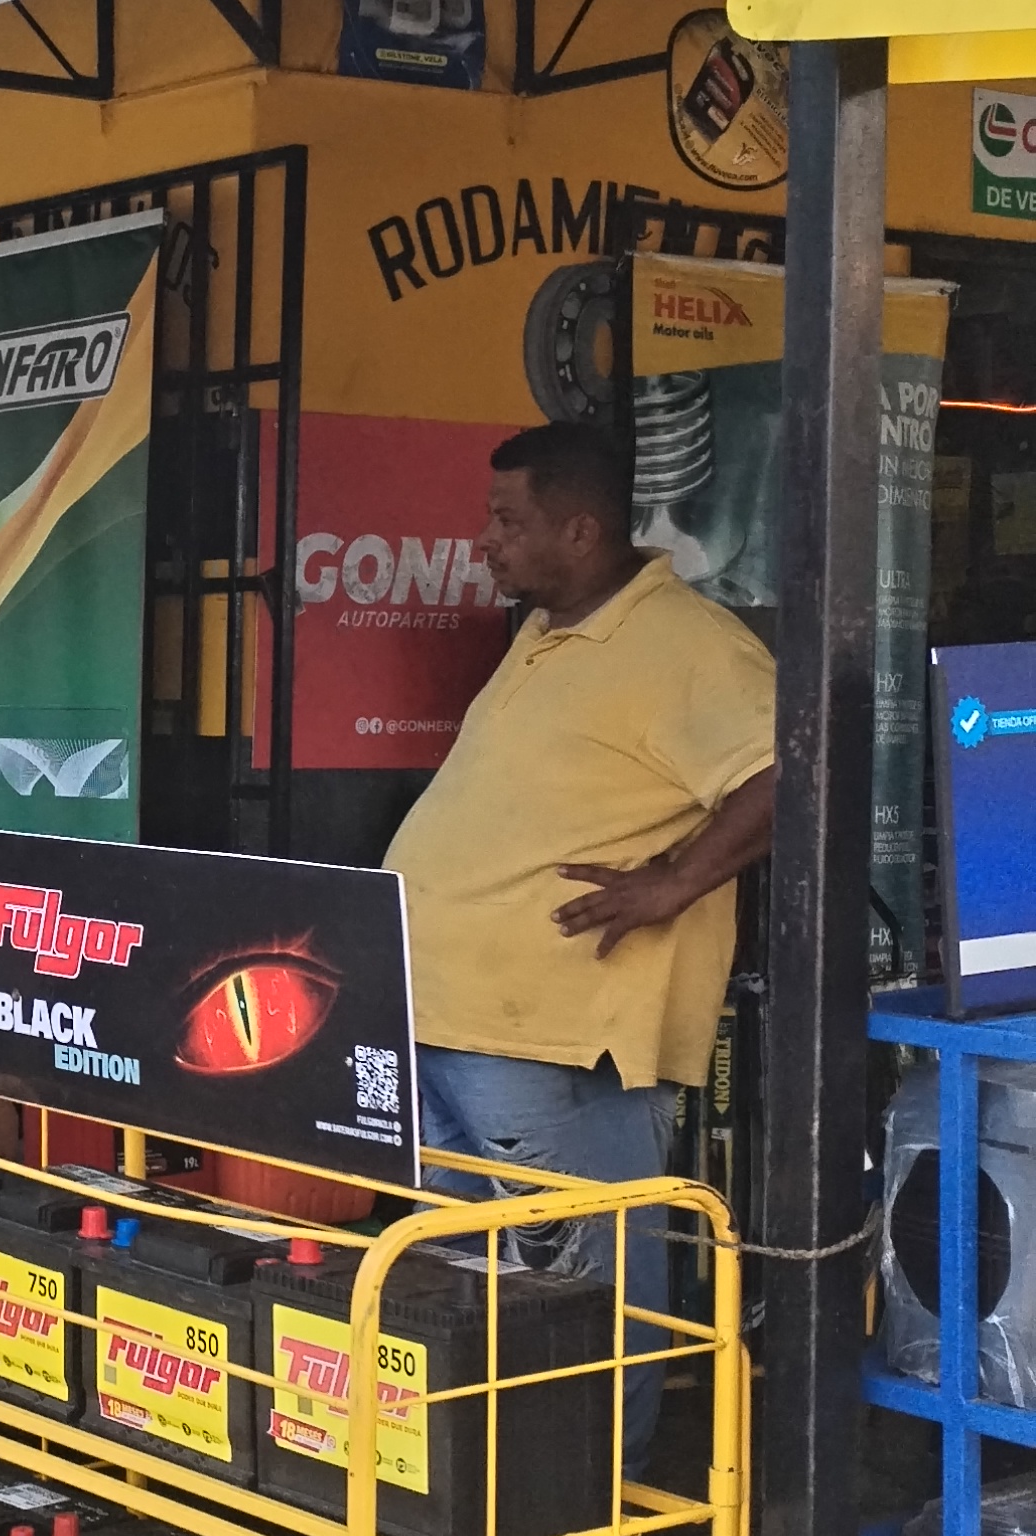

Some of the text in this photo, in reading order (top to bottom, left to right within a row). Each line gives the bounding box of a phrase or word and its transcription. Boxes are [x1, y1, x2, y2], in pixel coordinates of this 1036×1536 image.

[985, 186, 1013, 209] DE
[653, 292, 750, 327] HELIX
[653, 323, 714, 342] Motor oils
[335, 609, 461, 632] AUTOPARTES
[875, 674, 904, 694] HX7
[874, 804, 900, 825] HX5
[54, 1044, 141, 1086] EDITION
[28, 1271, 58, 1300] 750
[186, 1325, 219, 1358] 850
[377, 1344, 416, 1378] 850
[107, 1399, 122, 1418] 18
[279, 1420, 323, 1443] 18 MESES
